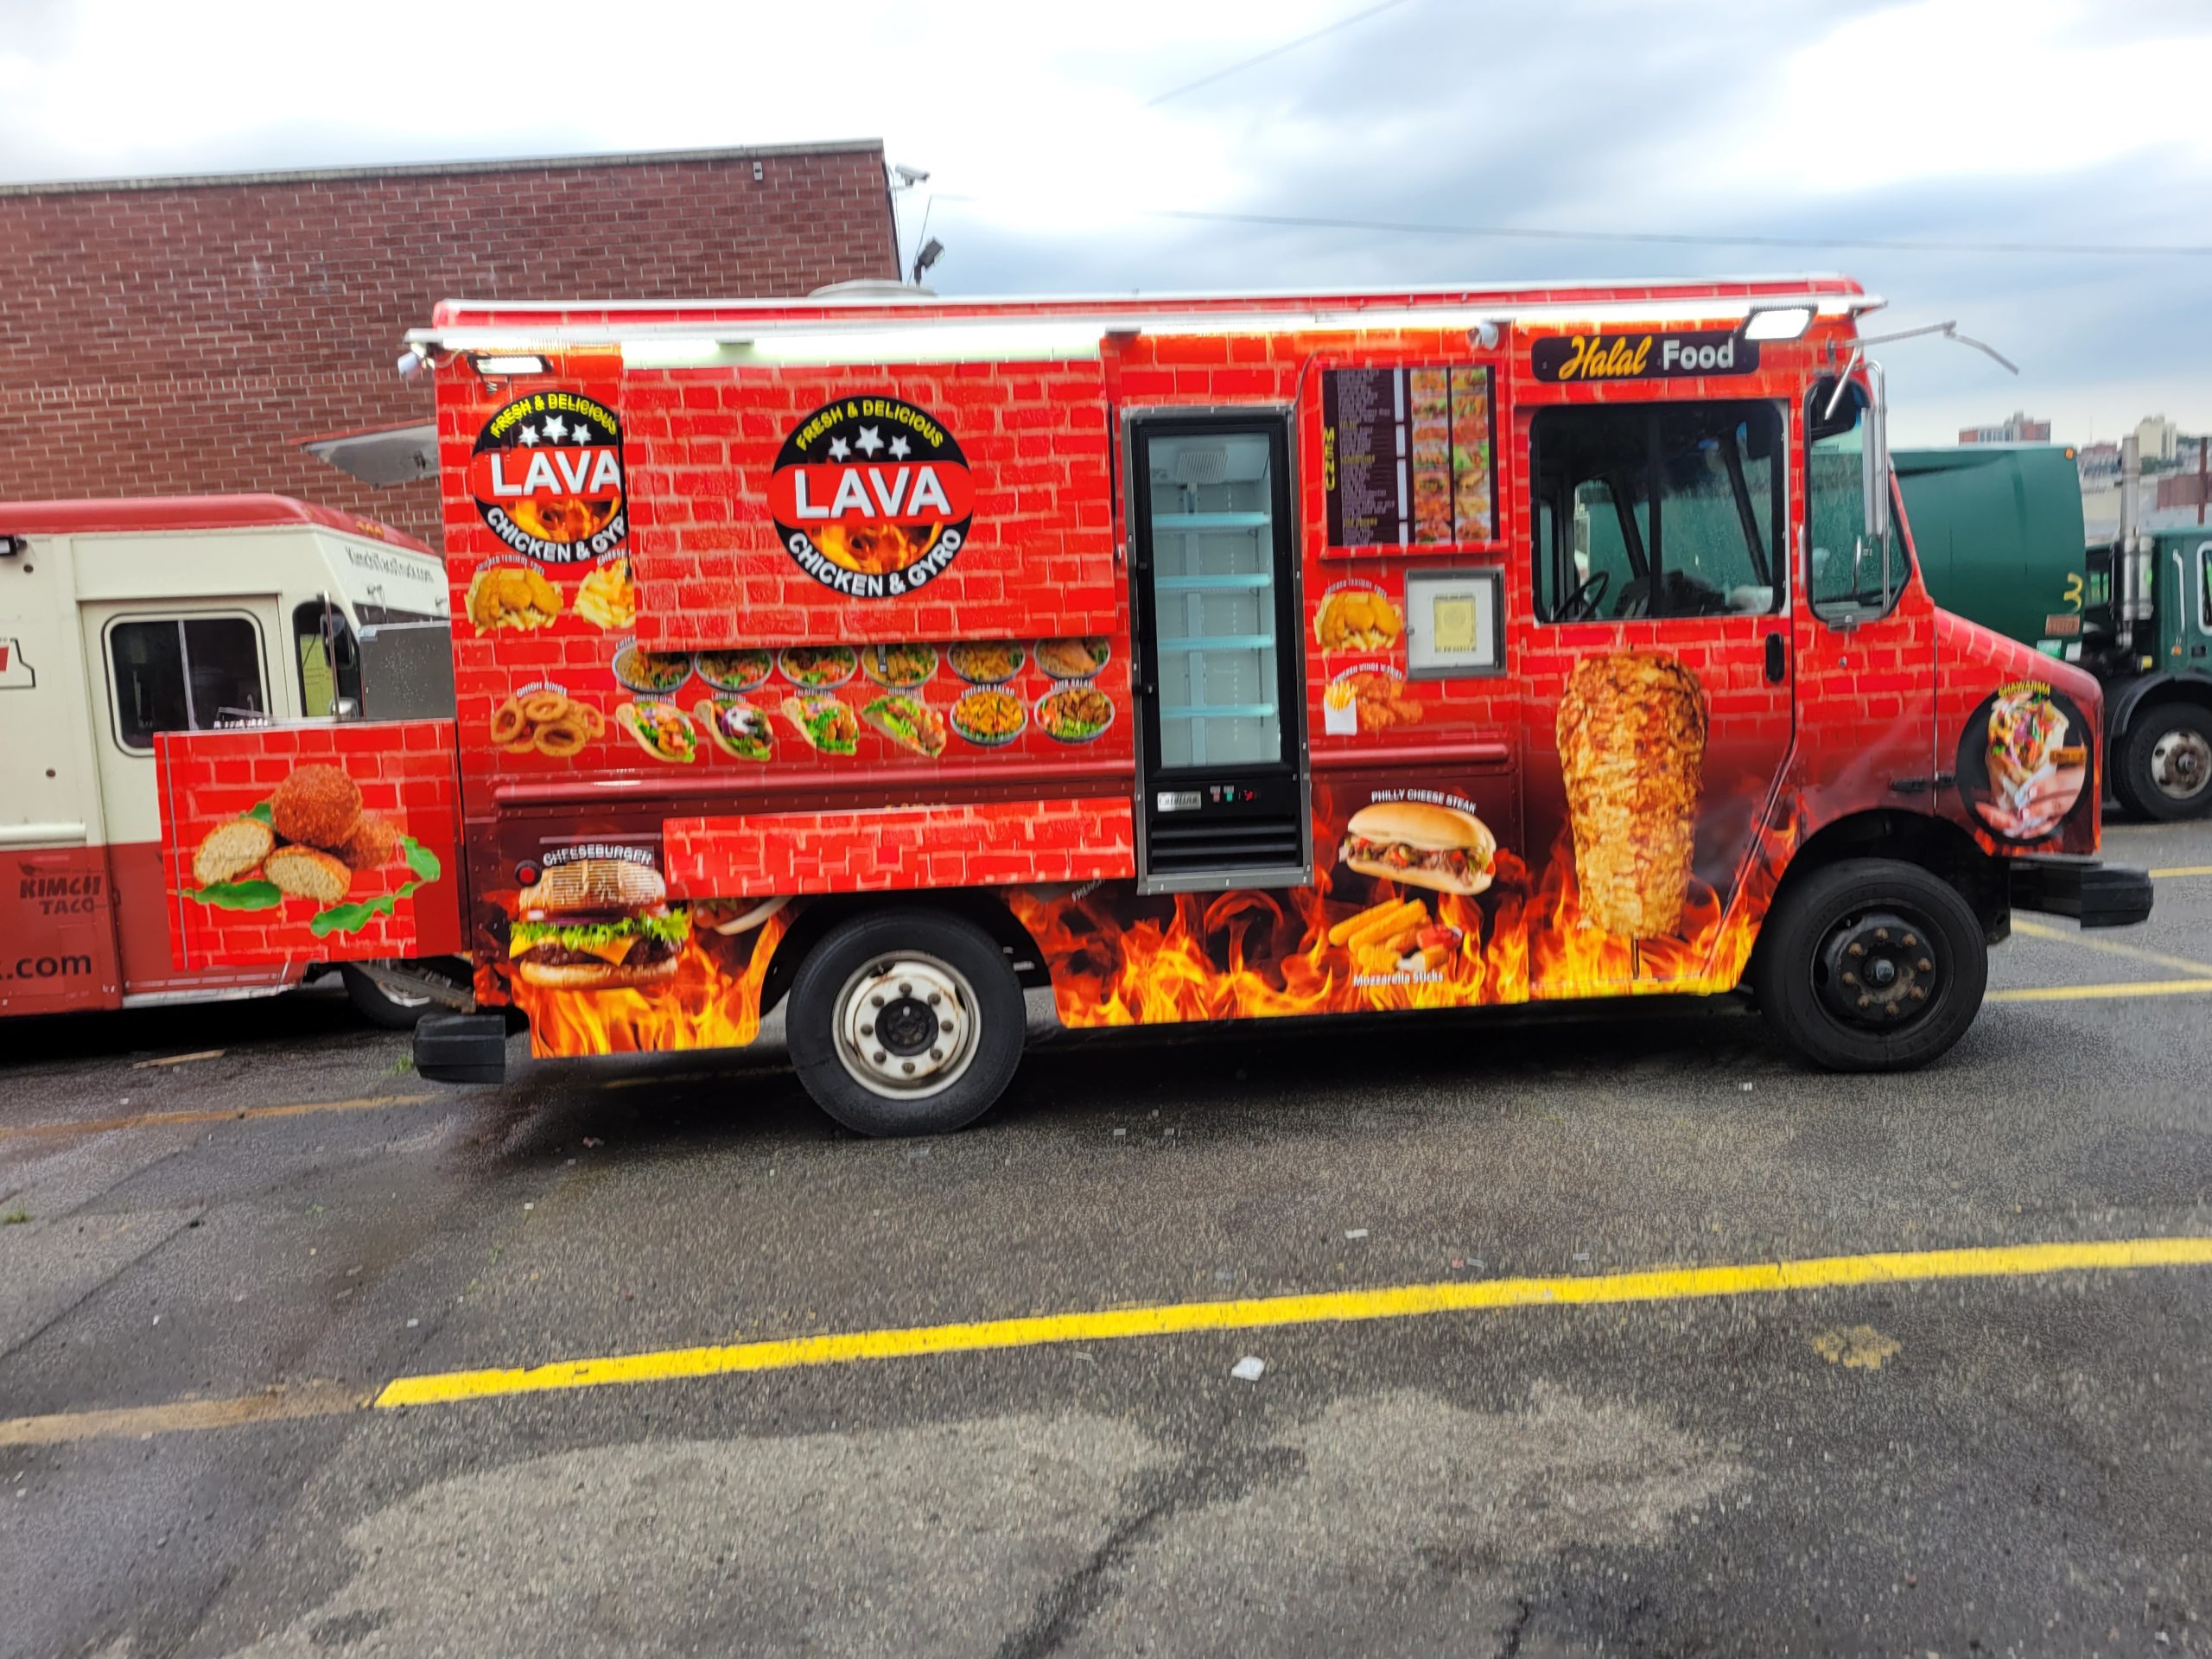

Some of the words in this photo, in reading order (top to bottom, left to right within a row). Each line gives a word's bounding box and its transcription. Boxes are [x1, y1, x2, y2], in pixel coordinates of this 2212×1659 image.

[1558, 334, 1652, 381] Halal
[1663, 336, 1733, 371] Food
[490, 398, 532, 438] FRESH
[534, 395, 545, 411] &
[796, 406, 843, 451] FRESH
[847, 401, 859, 418] &
[862, 399, 944, 448] DELICIOUS
[491, 449, 622, 497] LAVA
[1323, 426, 1335, 491] MENU
[794, 466, 951, 519] LAVA
[487, 507, 571, 562] CHICKEN
[575, 541, 591, 561] &
[789, 532, 883, 597] CHICKEN
[889, 572, 906, 594] &
[908, 529, 961, 587] GYRO
[2063, 572, 2083, 613] 3
[517, 681, 542, 698] ONION
[543, 681, 569, 696] RINGS
[1999, 681, 2050, 696] SHAWARMA
[1371, 788, 1405, 804] PHILLY
[1407, 788, 1444, 804] CHEESE
[1446, 794, 1477, 815] STEAK
[543, 843, 653, 867] CHEESEBURGER
[20, 875, 101, 899] KIMCHI
[39, 897, 94, 916] TACO
[1353, 971, 1410, 987] Mozzarella
[1413, 969, 1444, 983] Sticks
